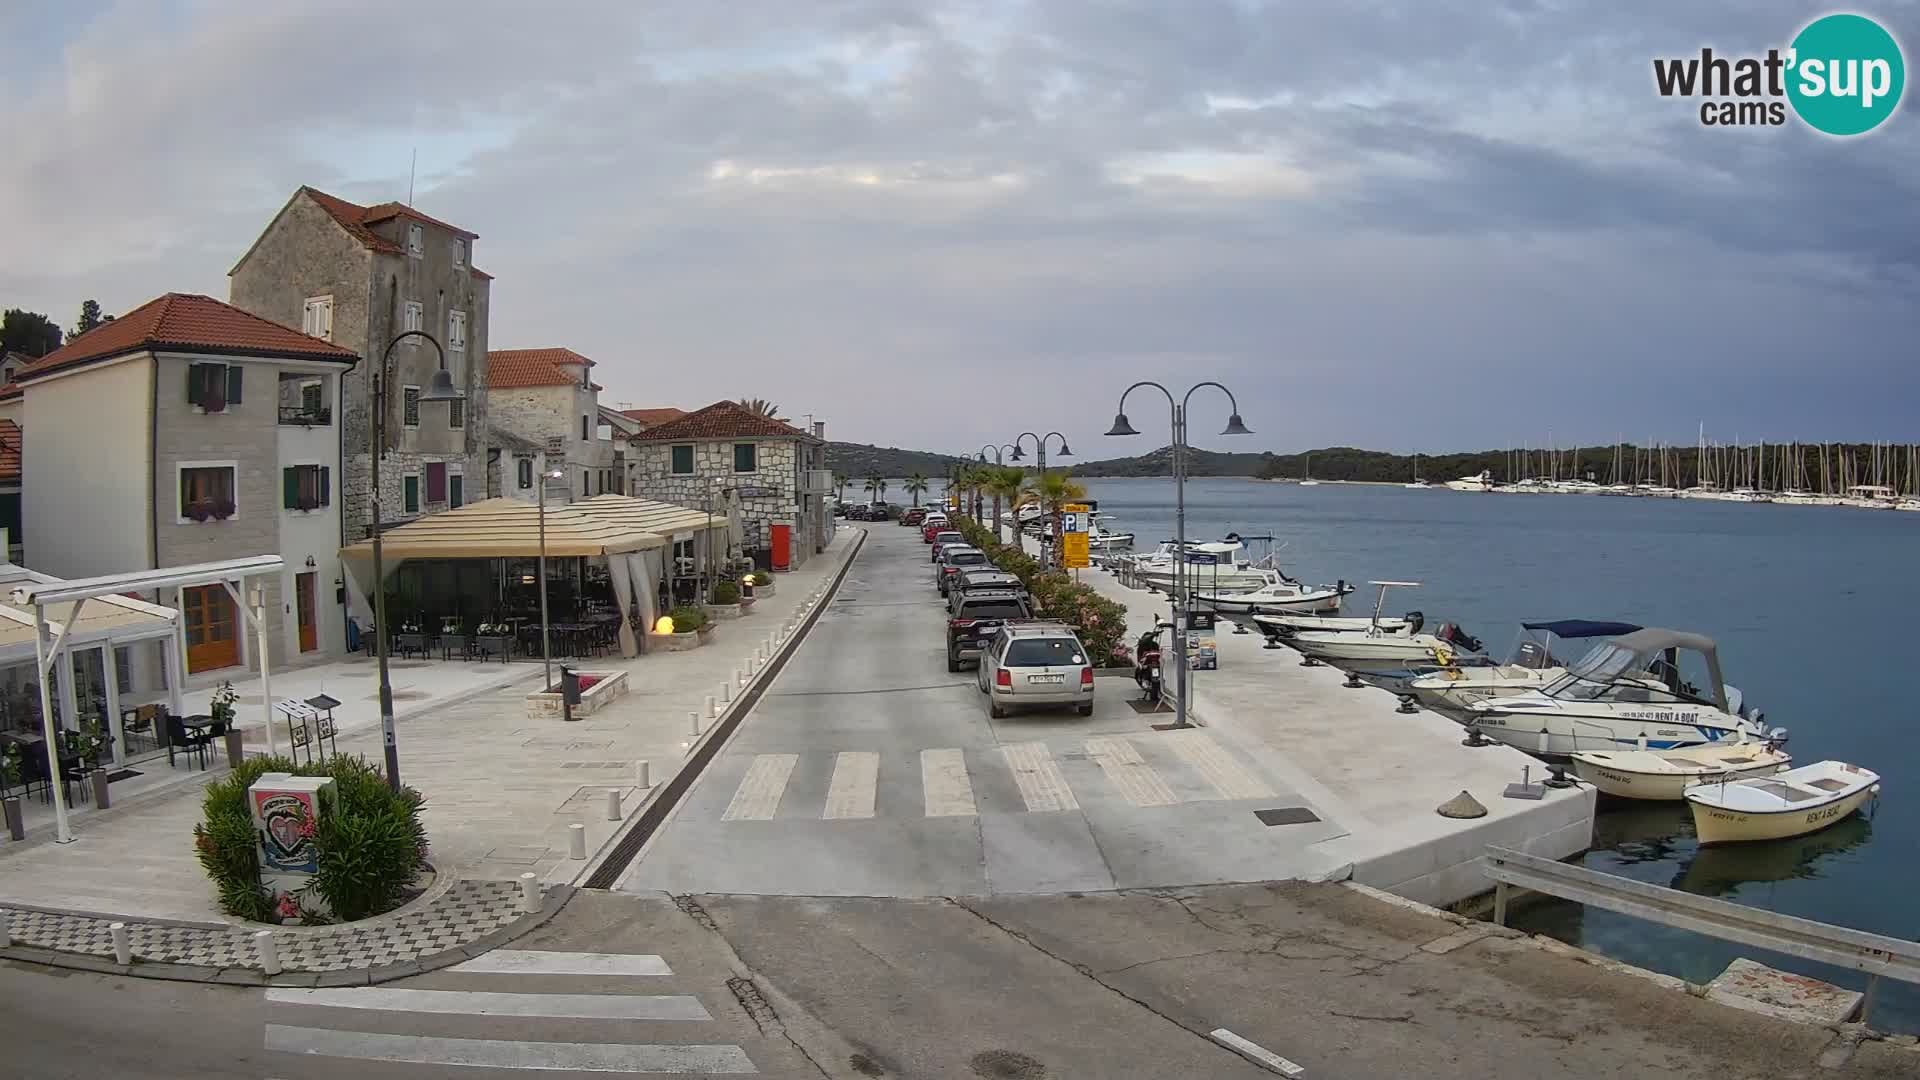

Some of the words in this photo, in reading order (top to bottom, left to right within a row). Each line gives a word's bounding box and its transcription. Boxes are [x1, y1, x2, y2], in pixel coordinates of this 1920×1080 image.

[1065, 514, 1076, 531] P
[1655, 712, 1674, 721] RENT
[1675, 713, 1680, 722] A
[1681, 712, 1698, 724] BOAT
